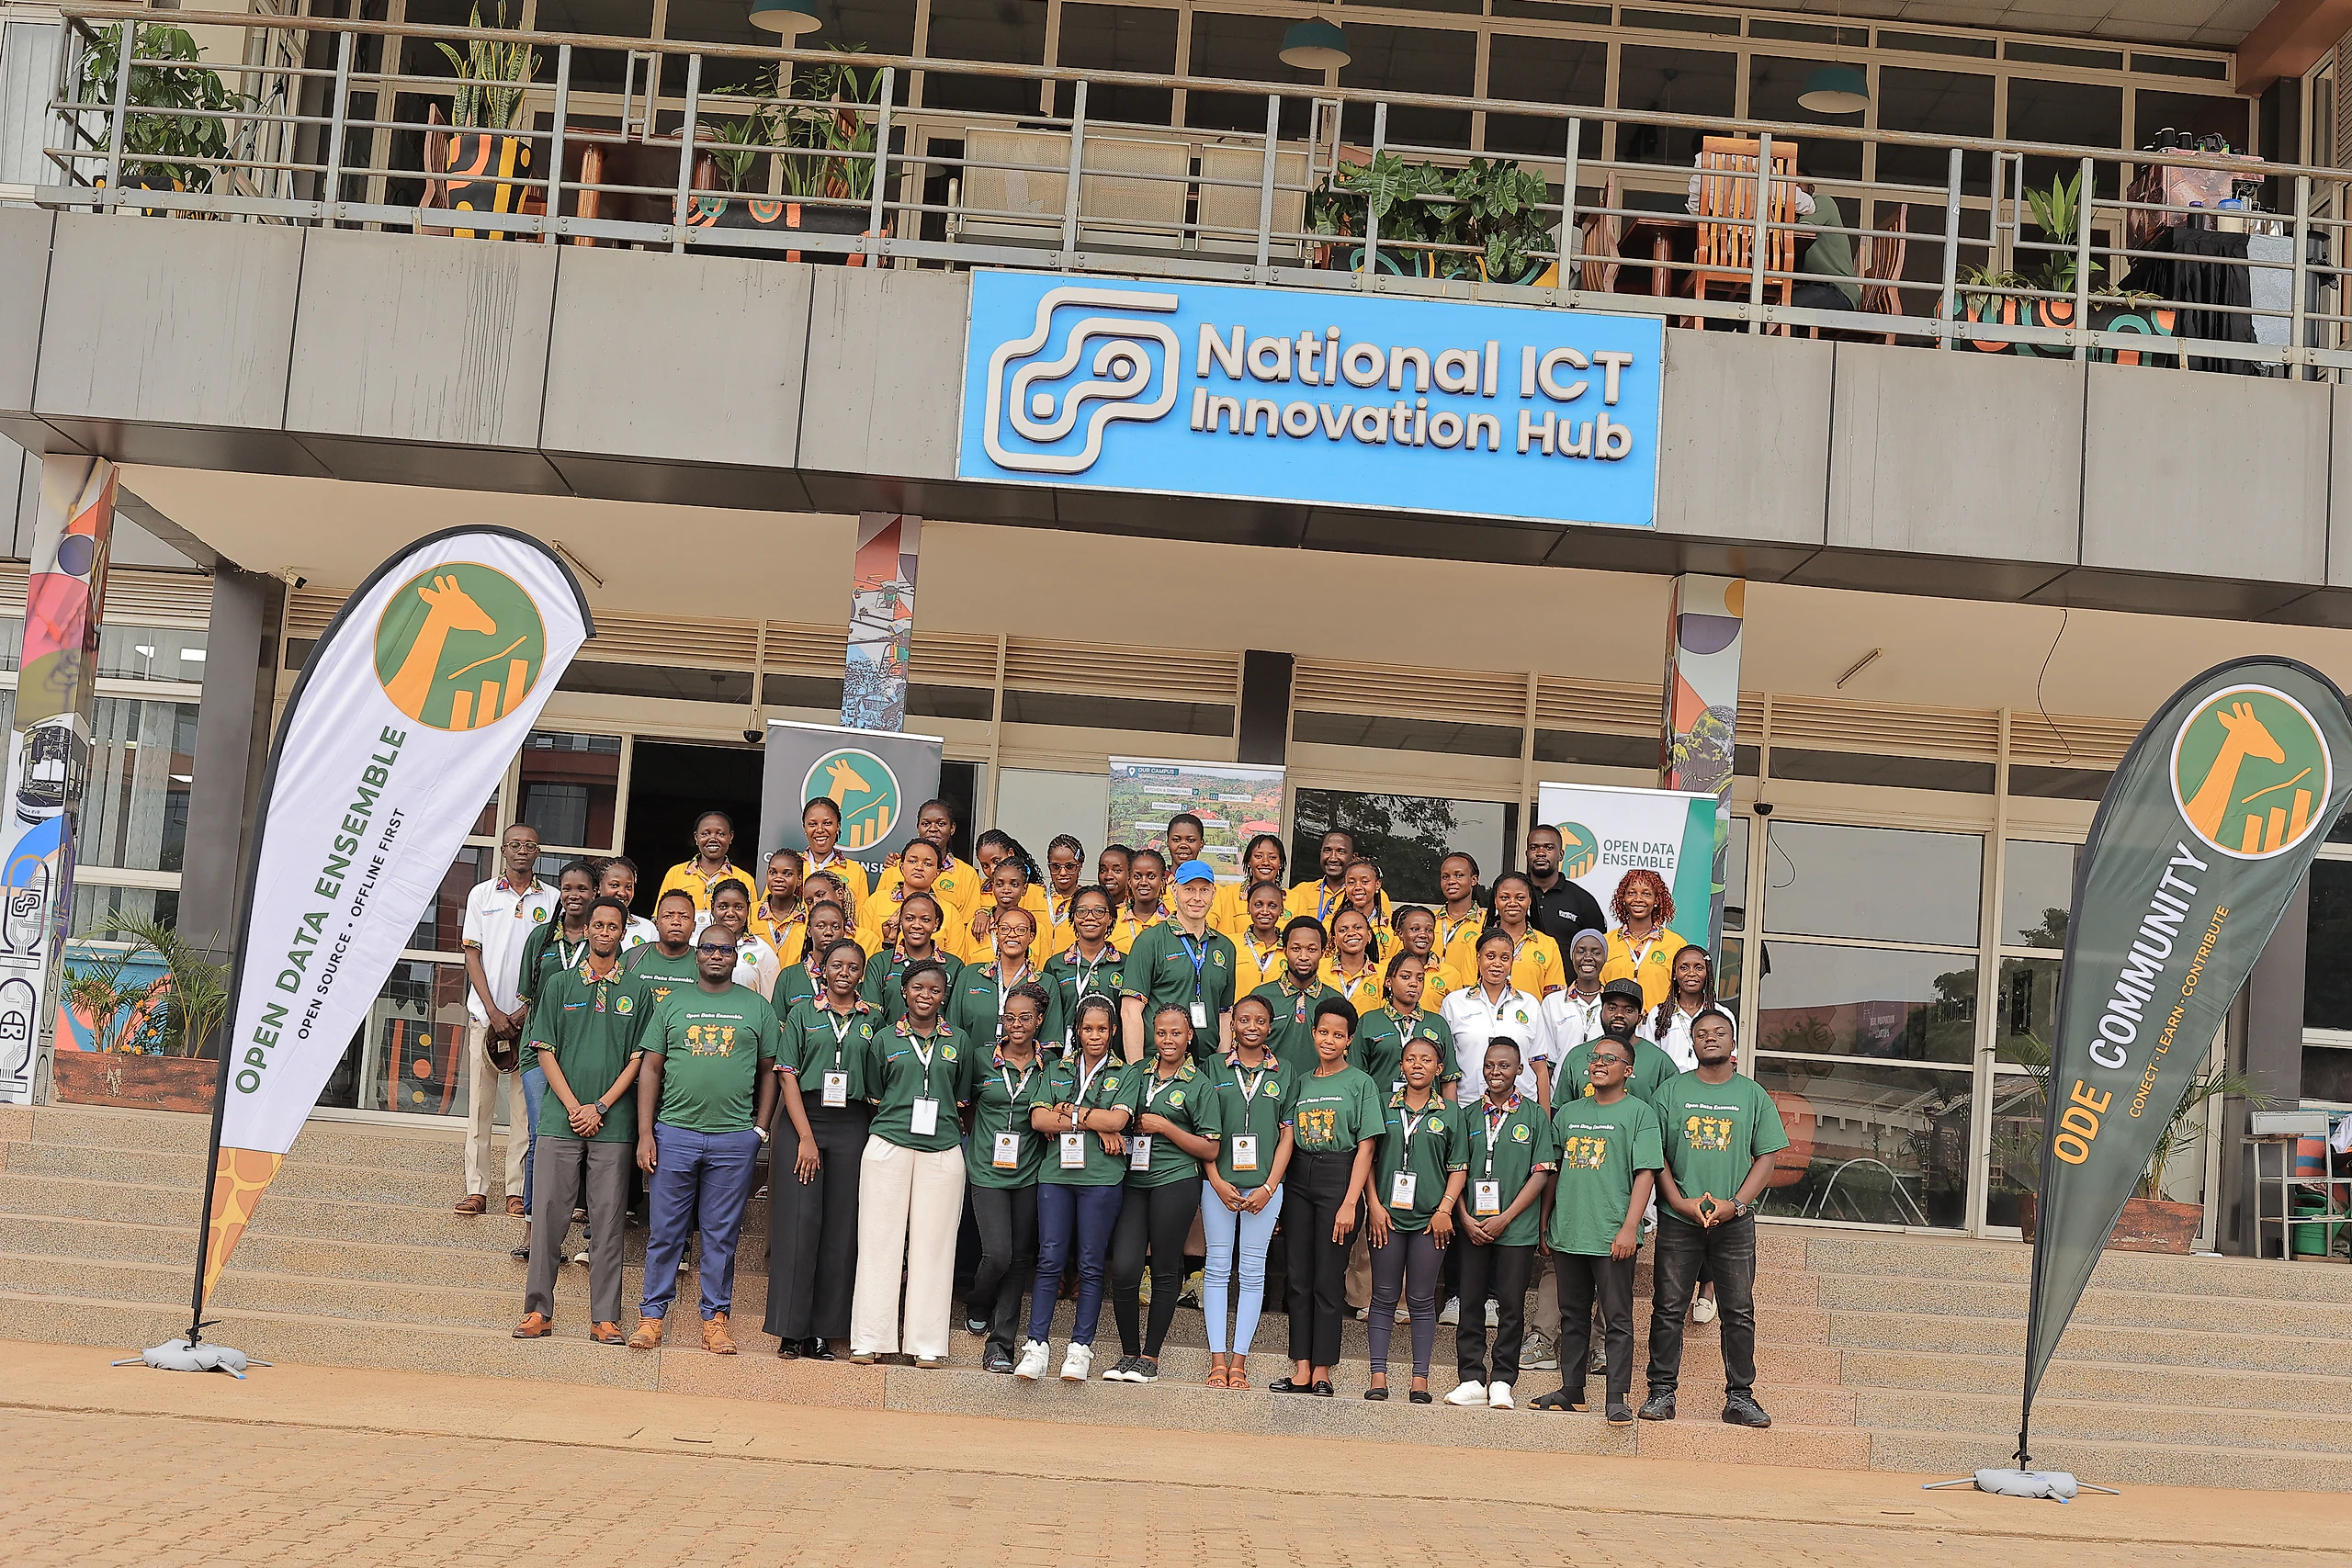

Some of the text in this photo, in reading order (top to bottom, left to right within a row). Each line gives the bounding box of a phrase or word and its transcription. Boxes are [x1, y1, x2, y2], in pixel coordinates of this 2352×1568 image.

[1190, 386, 1634, 460] Innovation Hub
[1196, 323, 1634, 406] National ICT
[235, 725, 407, 1094] OPEN DATA ENSEMBLE
[1603, 840, 1674, 855] OPEN DATA
[1603, 853, 1674, 869] ENSEMBLE
[298, 807, 405, 1040] OPEN SOURCE OFFLINE FIRST
[2053, 840, 2208, 1165] ODE COMMUNITY
[2129, 905, 2229, 1118] CONECT LEARN CONTRIBUTE
